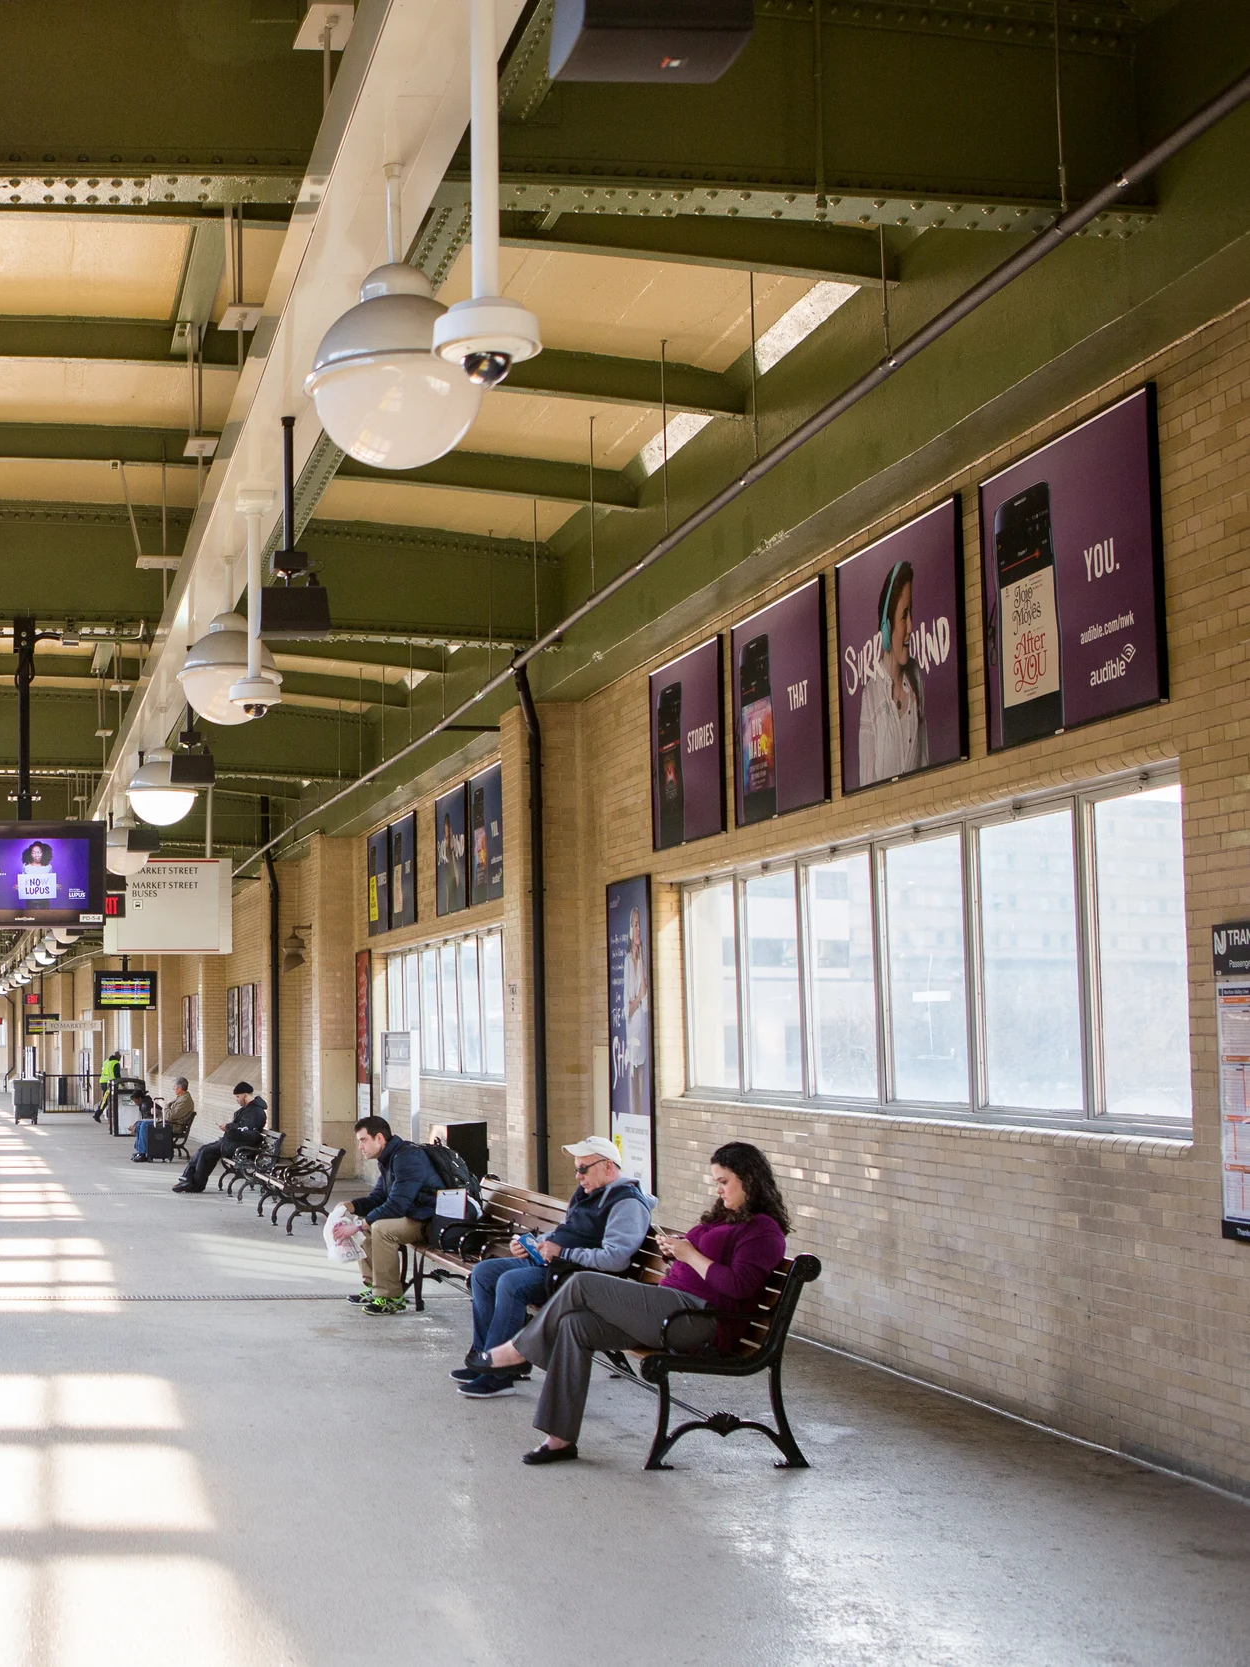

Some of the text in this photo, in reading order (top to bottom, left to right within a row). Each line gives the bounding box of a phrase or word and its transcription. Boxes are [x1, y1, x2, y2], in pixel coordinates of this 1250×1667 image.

[1083, 537, 1120, 582] YOU.
[1014, 584, 1033, 609] Jojo
[1080, 610, 1135, 645] audible.com/nwk
[1014, 630, 1046, 659] After
[1013, 650, 1048, 692] YOU
[1090, 656, 1126, 687] audible
[787, 679, 808, 711] THAT
[687, 722, 714, 754] STORIES
[24, 878, 50, 886] KNOW
[135, 867, 199, 875] ARKET STREET
[25, 886, 50, 895] LUPUS
[132, 890, 158, 898] BUSES
[105, 897, 118, 914] XIT
[27, 995, 38, 1004] EXIT
